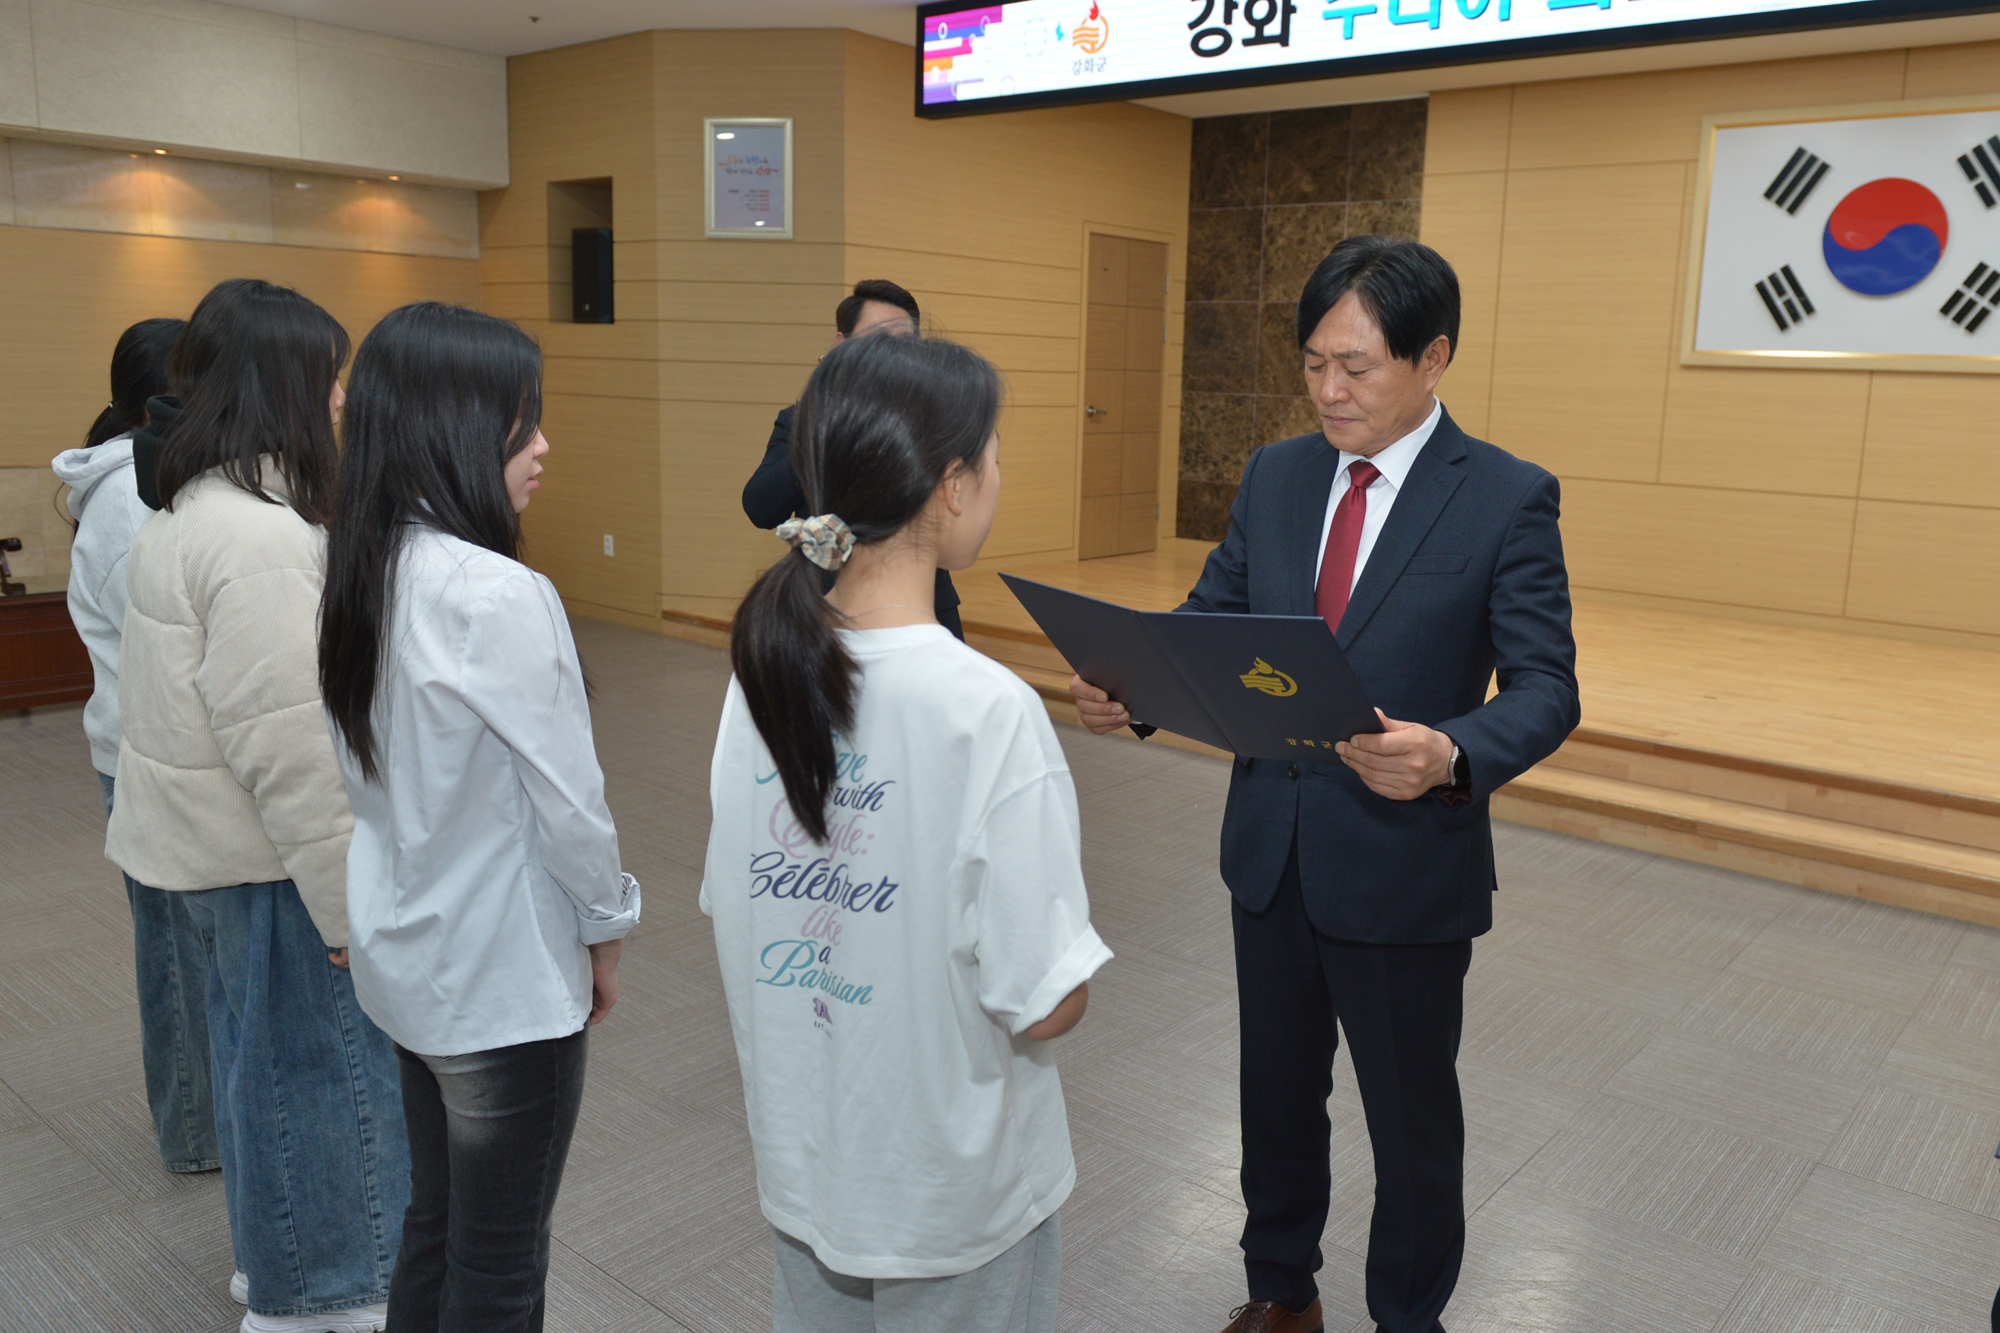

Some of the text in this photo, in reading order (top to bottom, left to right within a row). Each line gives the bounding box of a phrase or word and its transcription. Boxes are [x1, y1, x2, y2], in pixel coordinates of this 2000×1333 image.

[1071, 57, 1107, 76] 강화군
[833, 780, 896, 812] with
[800, 904, 843, 946] like
[818, 945, 832, 965] a
[755, 939, 874, 1005] Parisian
